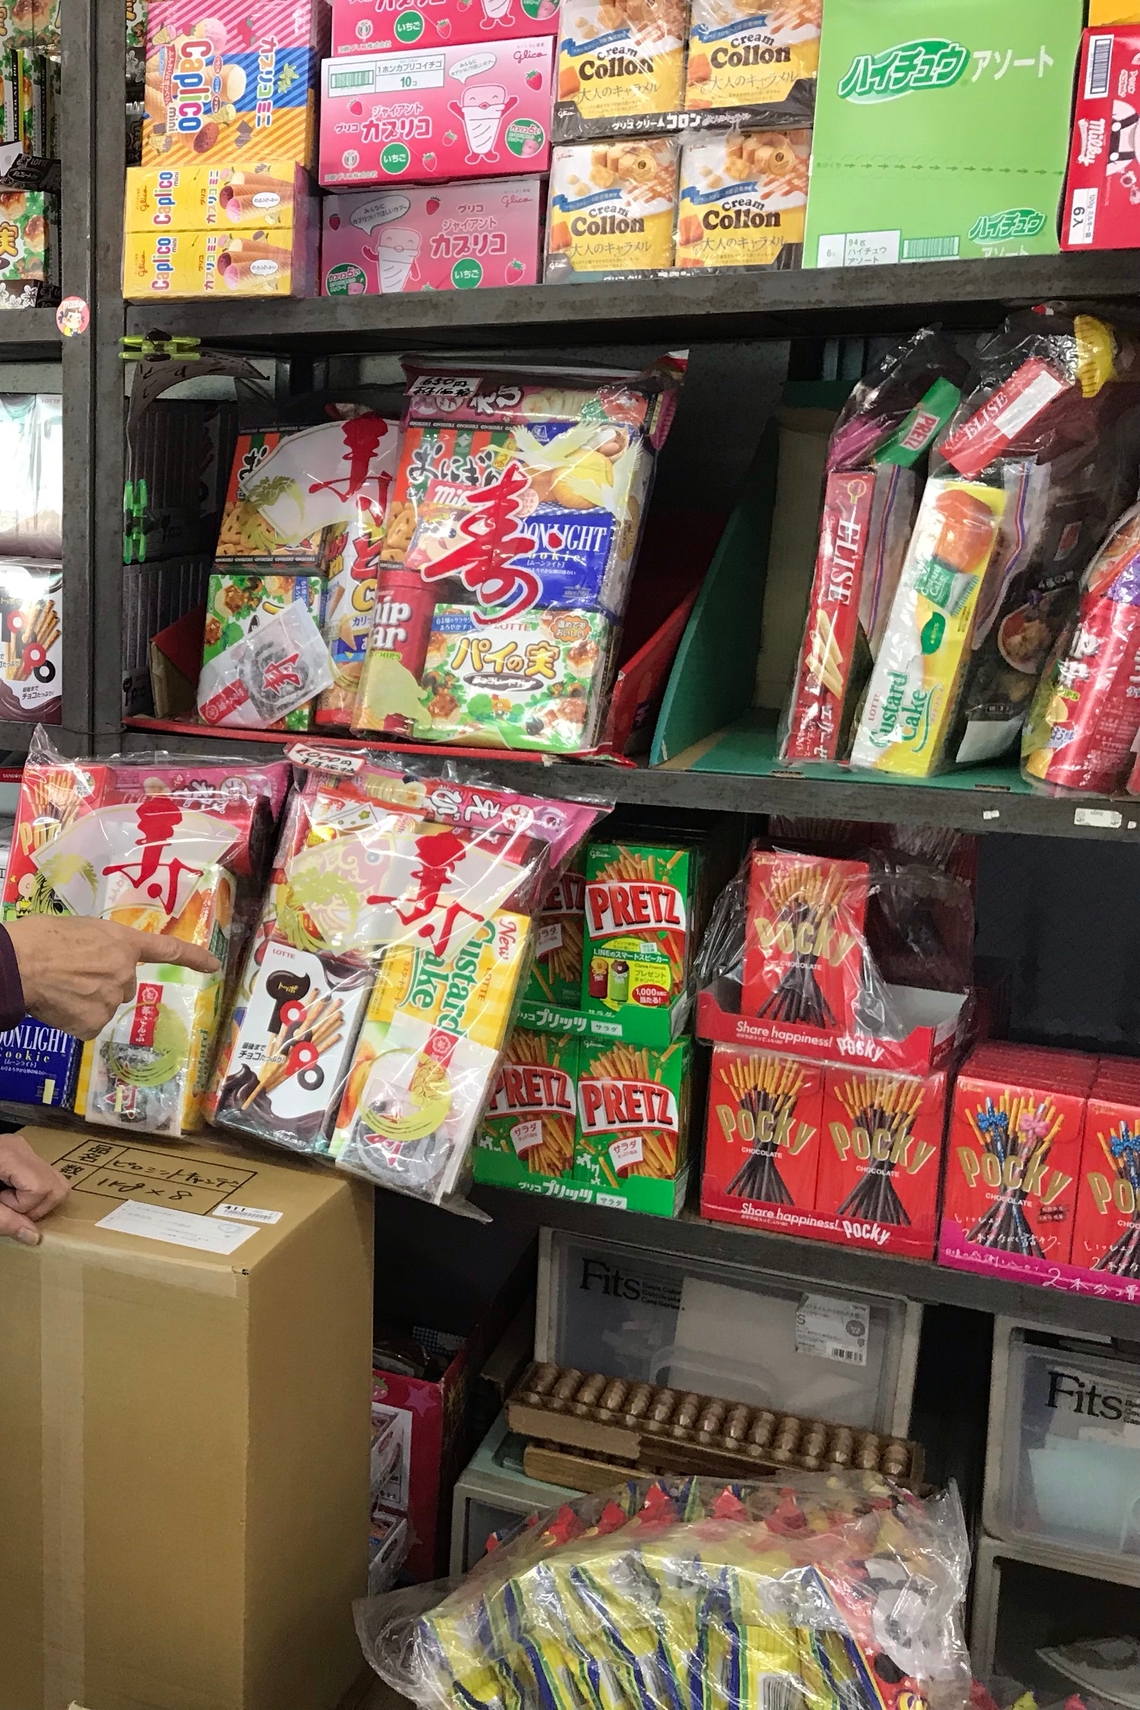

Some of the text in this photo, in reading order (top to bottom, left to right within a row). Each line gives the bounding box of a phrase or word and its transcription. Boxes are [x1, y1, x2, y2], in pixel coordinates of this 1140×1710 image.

[396, 22, 422, 33] いちご
[730, 32, 775, 48] Cream
[597, 46, 638, 61] Cream
[711, 45, 791, 69] Collon
[579, 57, 654, 81] Collon
[838, 43, 1054, 99] ハイチュウ アソート
[168, 40, 213, 133] Caplico mini
[256, 35, 277, 129] カプリコミニ
[579, 81, 661, 103] 大人のキャラメル
[710, 71, 800, 91] 大人のキャラメル
[372, 102, 424, 119] ジャイアント
[667, 113, 702, 129] コロン
[334, 116, 433, 143] グリコ カプリコ
[383, 154, 407, 164] いちご
[154, 171, 181, 226] Caplico mini
[206, 169, 218, 225] カプリコミニ
[721, 198, 765, 212] Cream
[457, 203, 484, 214] グリコ
[588, 205, 629, 218] Cream
[702, 208, 782, 230] Collon
[1073, 206, 1086, 228] 6入
[442, 217, 497, 232] ジャイアント
[571, 215, 645, 236] Collon
[968, 212, 1047, 241] ハイチュウ
[429, 231, 508, 259] カプリコ
[570, 240, 653, 259] 大人のキャラメル
[701, 234, 788, 254] 大人のキャラメル
[847, 246, 888, 258] ハイチュウ
[151, 237, 172, 291] Caplico
[205, 236, 216, 292] カプリコミニ
[454, 269, 480, 280] いちご
[963, 391, 1009, 440] ELISE
[308, 411, 393, 527] 寿
[421, 460, 546, 626] 寿
[829, 515, 863, 607] ELISE
[555, 627, 588, 639] おいしい
[451, 636, 561, 680] パイの実
[901, 689, 928, 741] Cake
[101, 794, 204, 916] 寿
[366, 832, 485, 958] 寿
[589, 885, 682, 931] PRETZ
[272, 949, 297, 960] LOTTE
[780, 959, 823, 971] CHOCOLATE
[634, 969, 667, 978] プレゼント
[536, 1009, 588, 1033] プリッツ
[735, 1020, 833, 1049] Share happiness!
[241, 1042, 267, 1053] 最後まで
[581, 1082, 674, 1128] PRETZ
[513, 1122, 537, 1136] サラダ
[613, 1139, 637, 1152] サラダ
[741, 1146, 783, 1160] CHOCOLATE
[855, 1165, 900, 1178] CHOCOLATE
[542, 1180, 593, 1203] プリッツ
[985, 1192, 1033, 1208] CHOCOLATE
[741, 1202, 774, 1219] Share
[774, 1208, 840, 1231] happiness!
[580, 1258, 641, 1301] Fits
[1047, 1370, 1123, 1421] Fits
